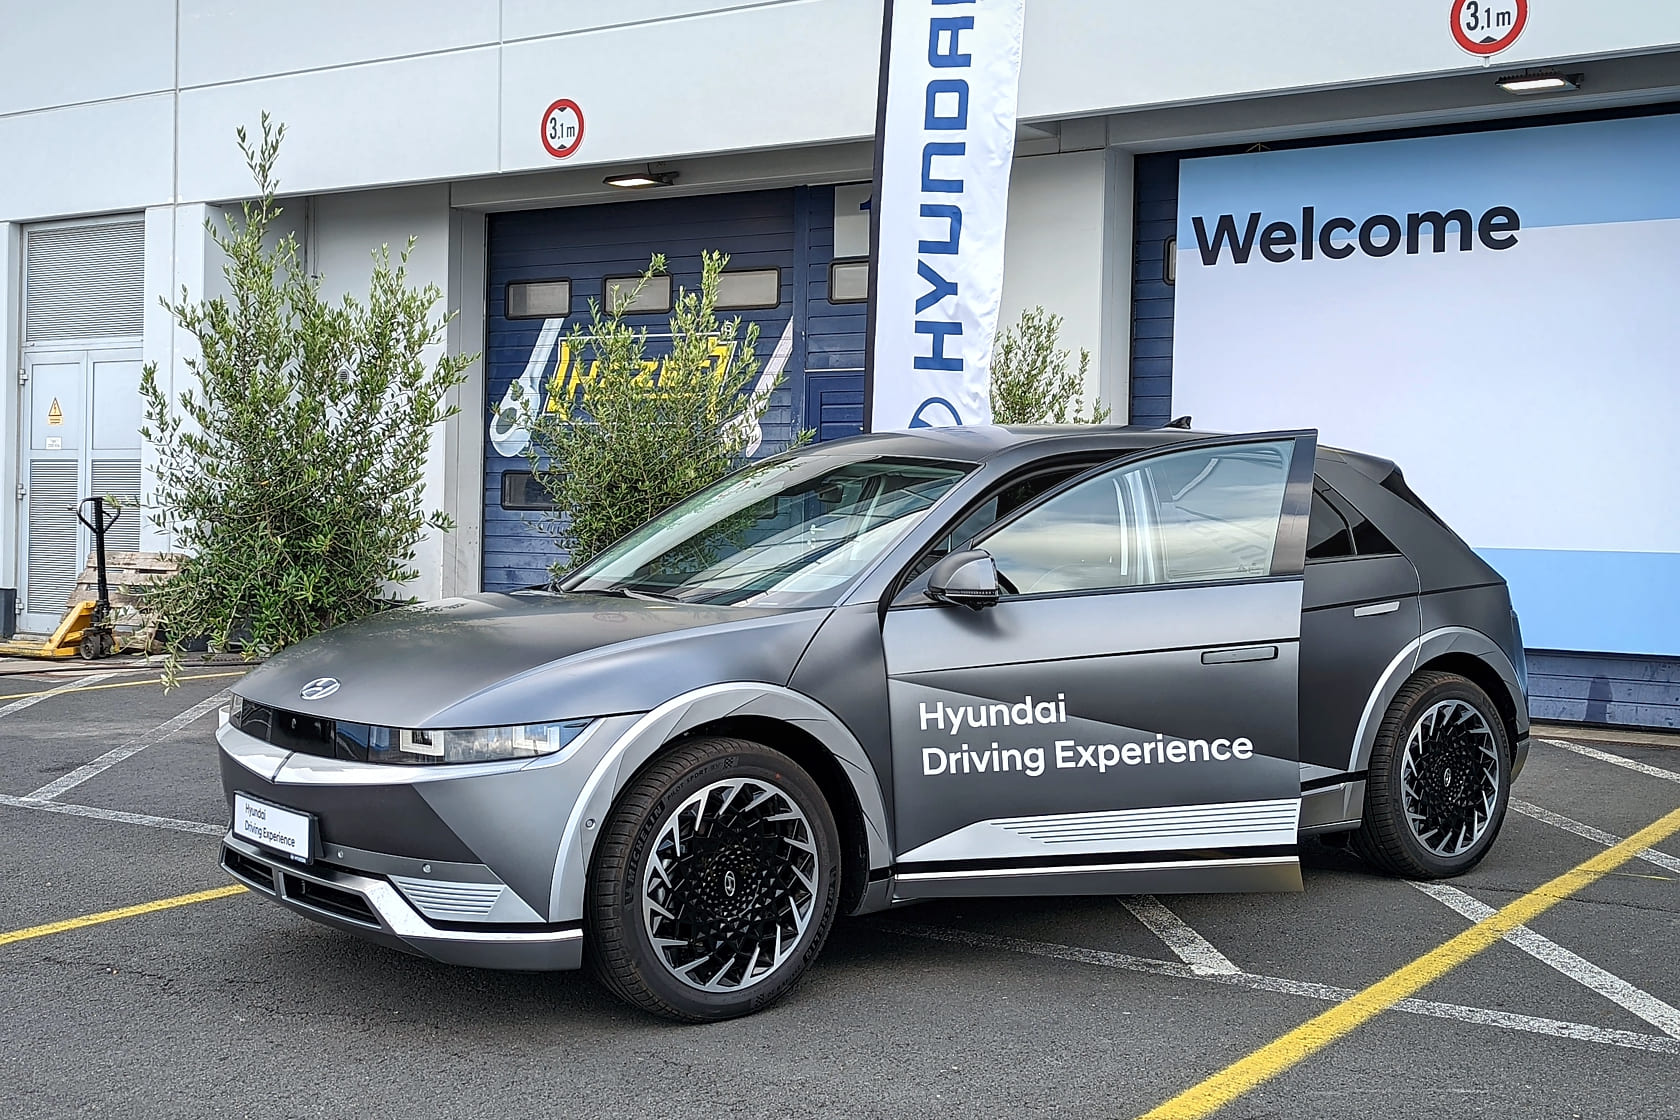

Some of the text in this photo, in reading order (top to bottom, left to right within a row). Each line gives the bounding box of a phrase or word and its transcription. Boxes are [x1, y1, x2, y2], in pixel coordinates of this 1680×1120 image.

[1191, 205, 1521, 266] Welcome
[919, 693, 1067, 735] Hyundai
[922, 733, 1253, 777] Driving Experience
[244, 819, 296, 848] Driving Experience
[245, 803, 267, 821] Hyundai
[626, 805, 664, 889] MICHELIN
